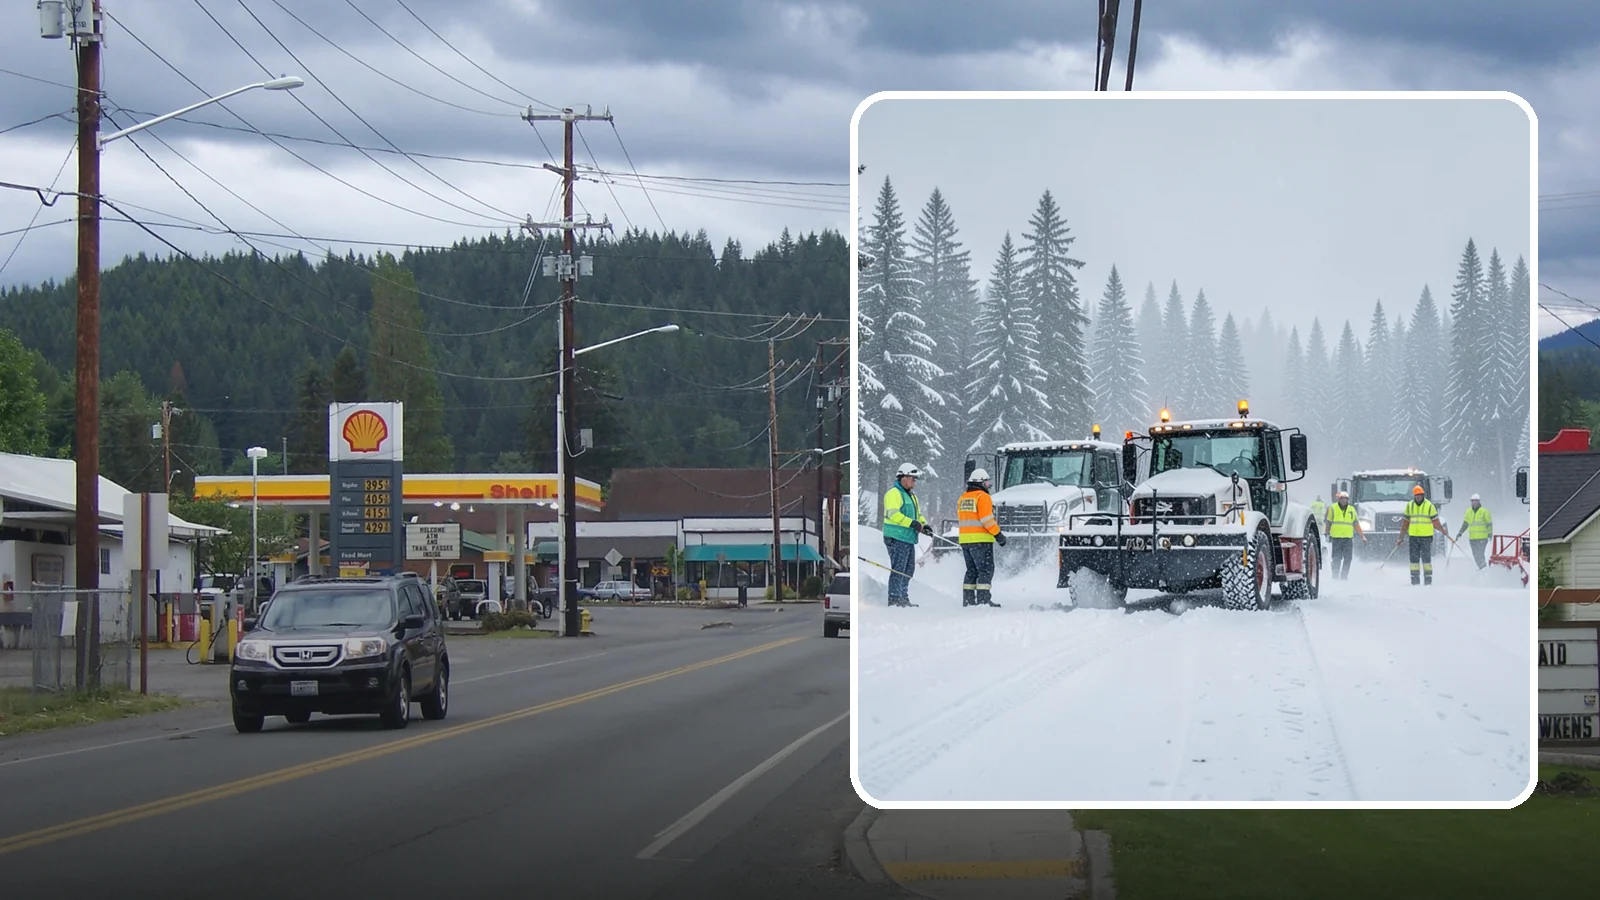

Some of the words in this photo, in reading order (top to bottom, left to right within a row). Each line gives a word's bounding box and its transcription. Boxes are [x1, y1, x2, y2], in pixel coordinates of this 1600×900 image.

[366, 480, 384, 490] 395
[490, 484, 547, 499] Shell
[366, 494, 384, 504] 405
[366, 522, 384, 532] 429
